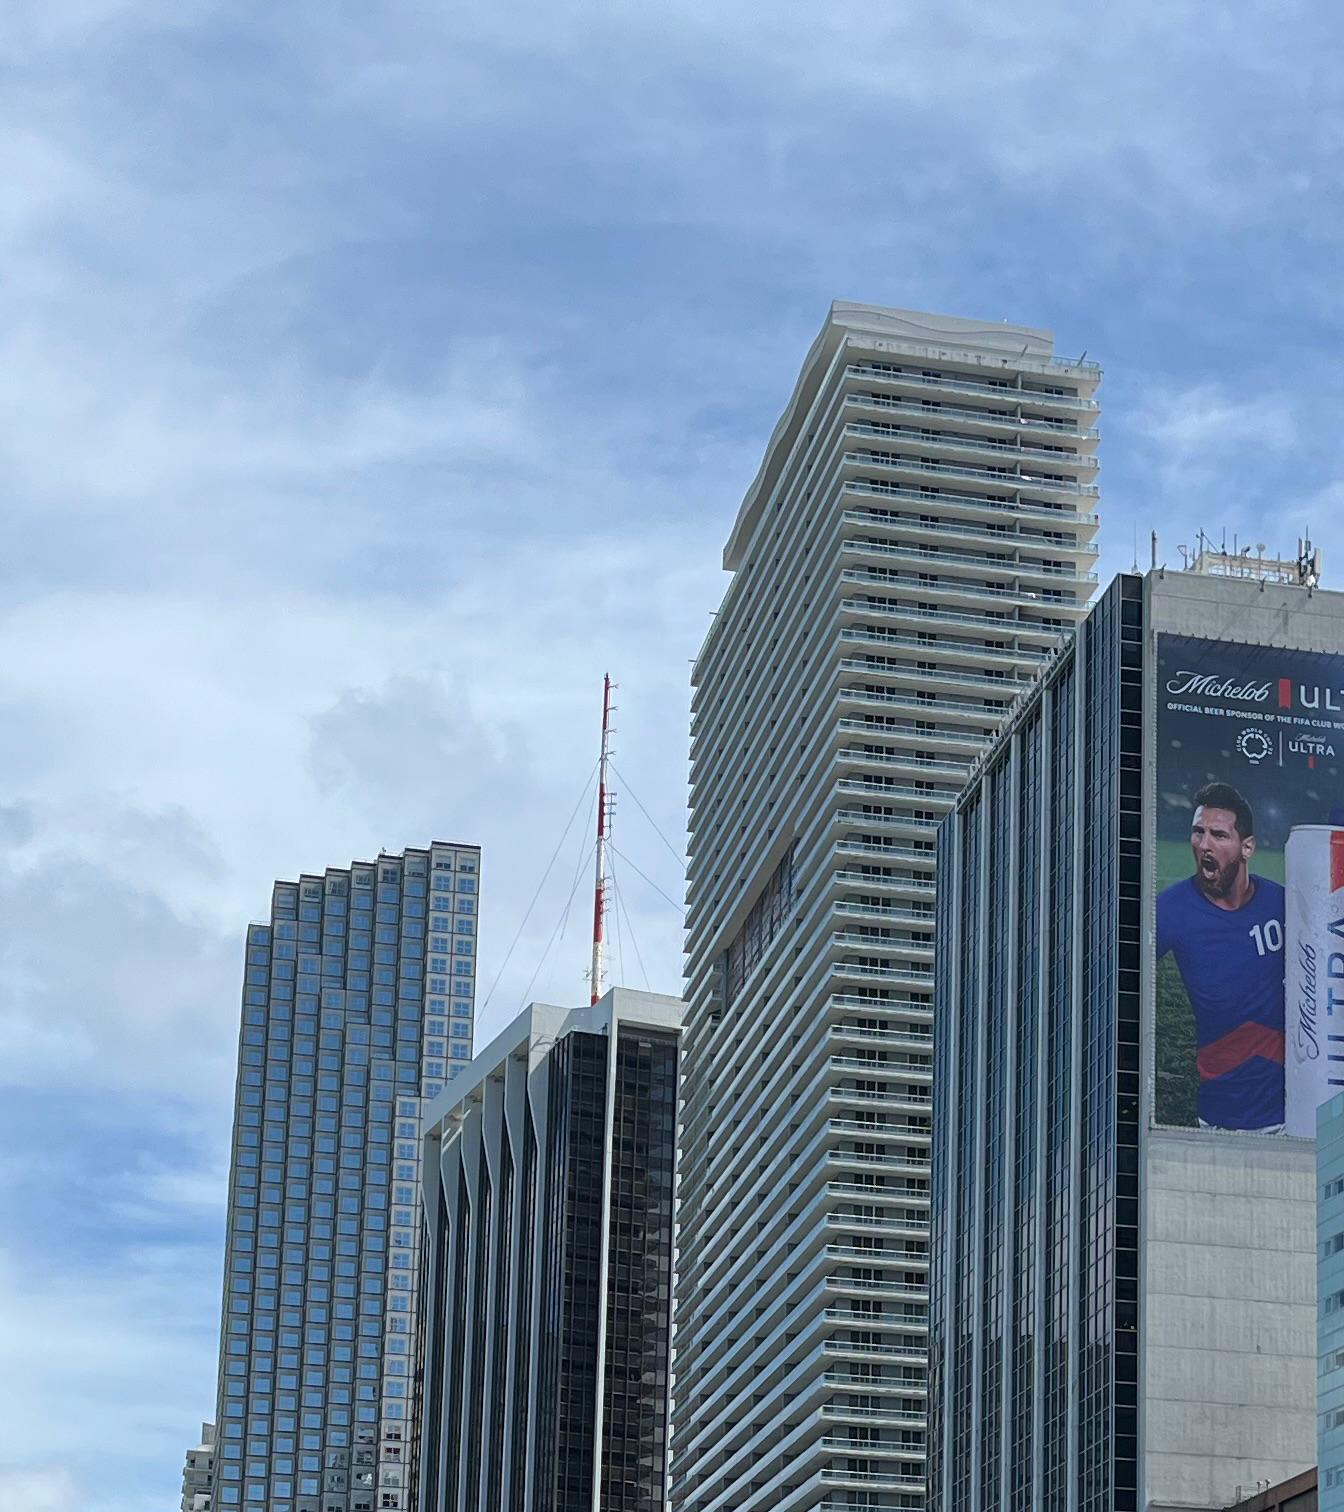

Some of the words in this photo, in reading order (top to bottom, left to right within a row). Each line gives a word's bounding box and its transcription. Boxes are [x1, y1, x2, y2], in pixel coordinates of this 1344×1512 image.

[1166, 670, 1273, 702] Michelob
[1167, 702, 1203, 714] OFFICIAL
[1204, 707, 1225, 716] BEER
[1226, 709, 1264, 721] SPONSOR
[1264, 714, 1275, 722] OF
[1276, 715, 1292, 724] THE
[1293, 717, 1311, 726] FIFA
[1311, 719, 1332, 728] CLUB
[1288, 741, 1336, 757] ULTRA
[1249, 919, 1283, 956] 10
[1298, 940, 1320, 1061] Michelob
